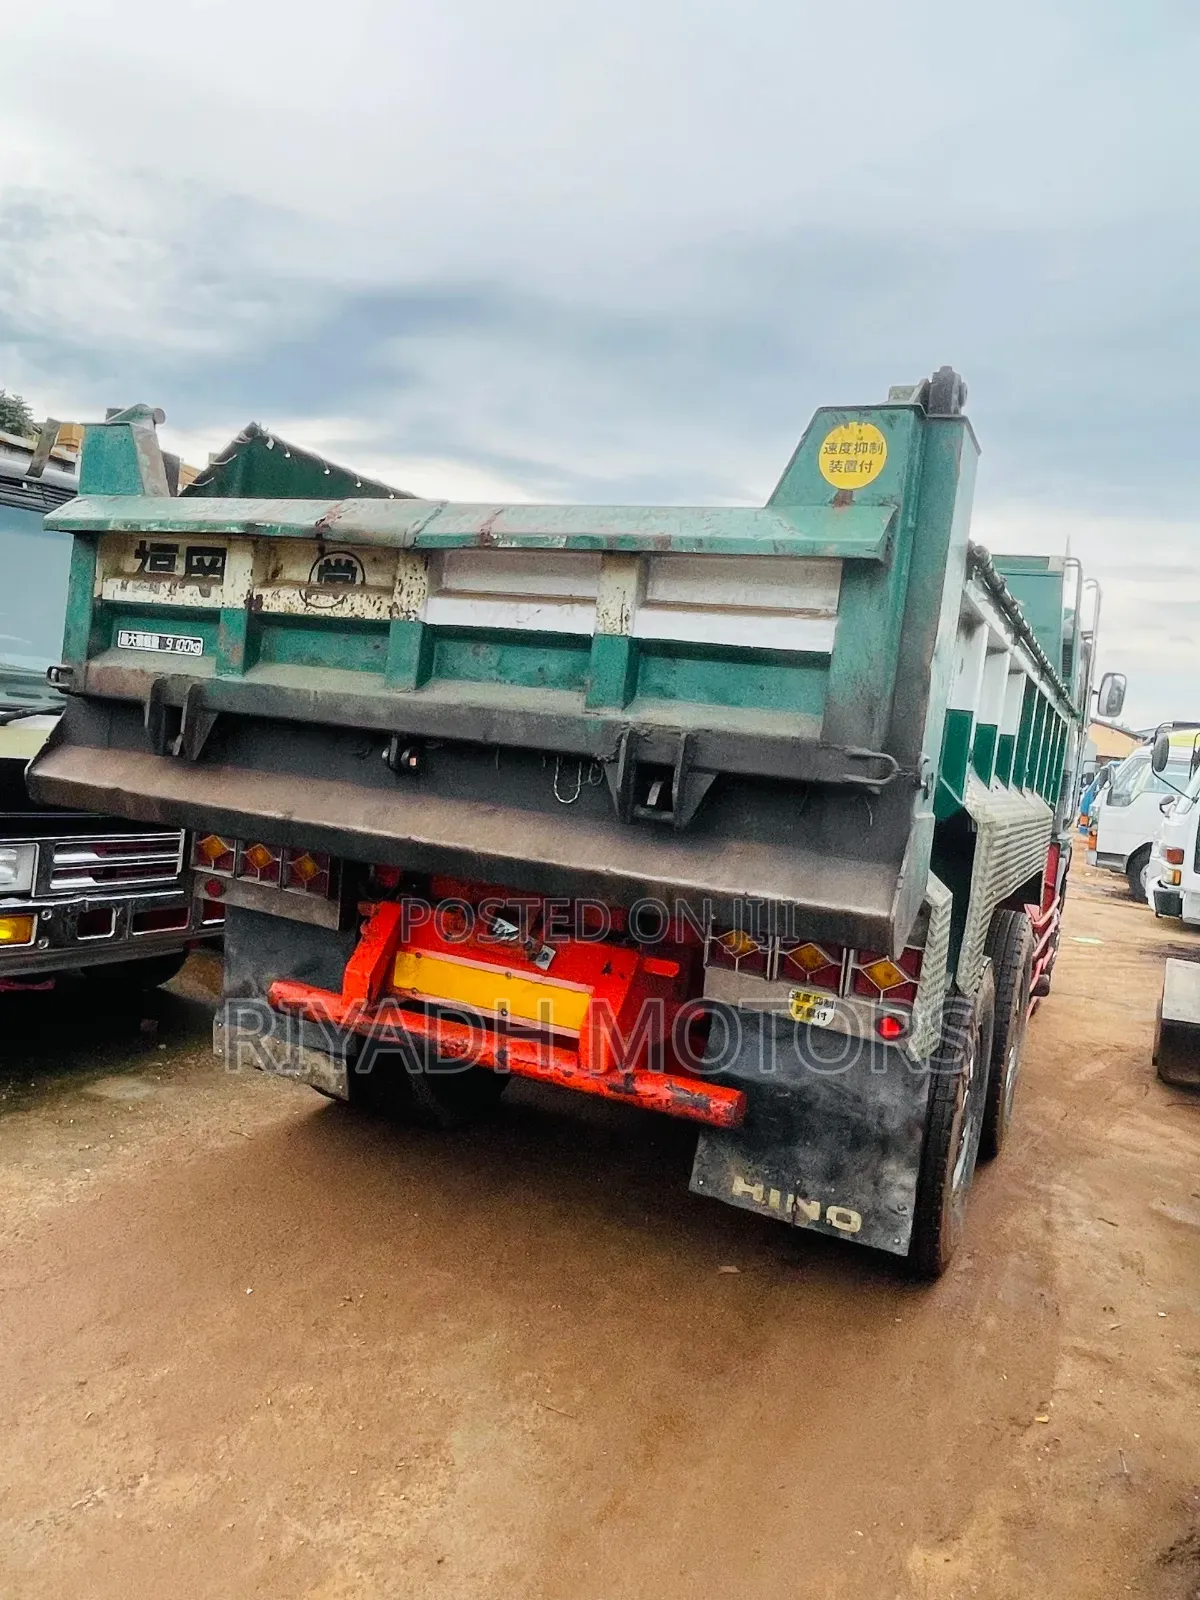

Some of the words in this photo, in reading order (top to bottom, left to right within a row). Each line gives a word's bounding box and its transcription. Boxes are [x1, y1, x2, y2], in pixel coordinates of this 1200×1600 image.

[823, 441, 884, 455] 速度抑制
[828, 460, 873, 474] 装置付
[732, 1175, 862, 1233] HINO
